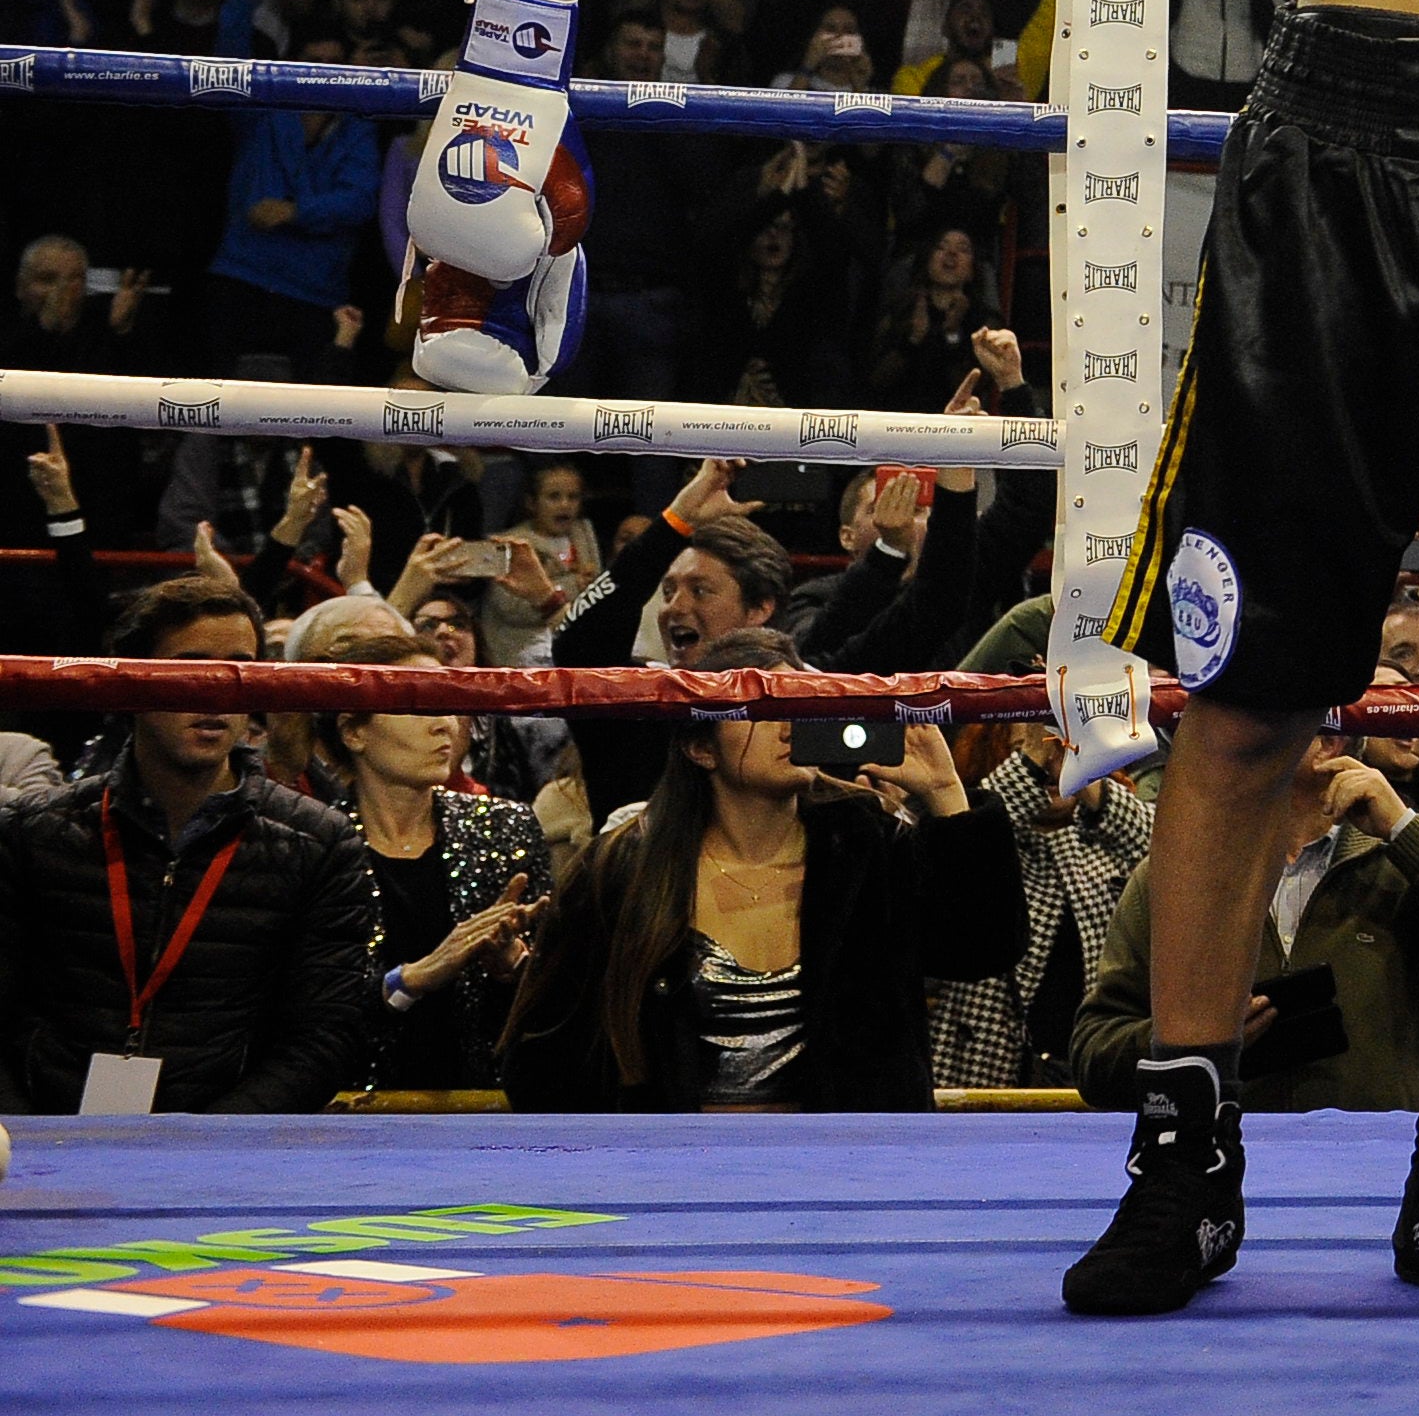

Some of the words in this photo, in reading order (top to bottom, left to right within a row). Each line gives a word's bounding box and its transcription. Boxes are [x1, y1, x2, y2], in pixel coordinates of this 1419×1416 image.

[63, 70, 160, 82] www.charlie.es
[190, 57, 252, 97] CHARLIE
[296, 75, 390, 87] www.charlie.es
[419, 72, 453, 102] CHA
[627, 82, 687, 109] CHARLIE
[834, 92, 892, 116] CHARLIE
[1033, 104, 1068, 122] CHAR
[1087, 83, 1141, 115] CHARLIE
[455, 102, 534, 130] WRAP
[1085, 171, 1139, 204] CHARLIE
[1085, 260, 1137, 293] CHARLIE
[1085, 349, 1137, 383] CHARLIE
[158, 397, 220, 429] CHARLIE
[258, 414, 353, 426] www.charlie.es
[383, 401, 444, 438] CHARLIE
[472, 418, 565, 430] www.charlie.es
[593, 405, 654, 445] CHARLIE
[682, 420, 772, 432] www.charlie.es
[800, 412, 859, 450] CHARLIE
[885, 424, 974, 436] www.charlie.es
[1001, 420, 1058, 452] CHARLIE
[1085, 440, 1137, 474] CHARLIE
[1183, 535, 1235, 604] LENGER
[1073, 614, 1107, 641] RLIE
[1075, 688, 1129, 725] CHARLIE
[0, 1203, 630, 1287] EUSKO
